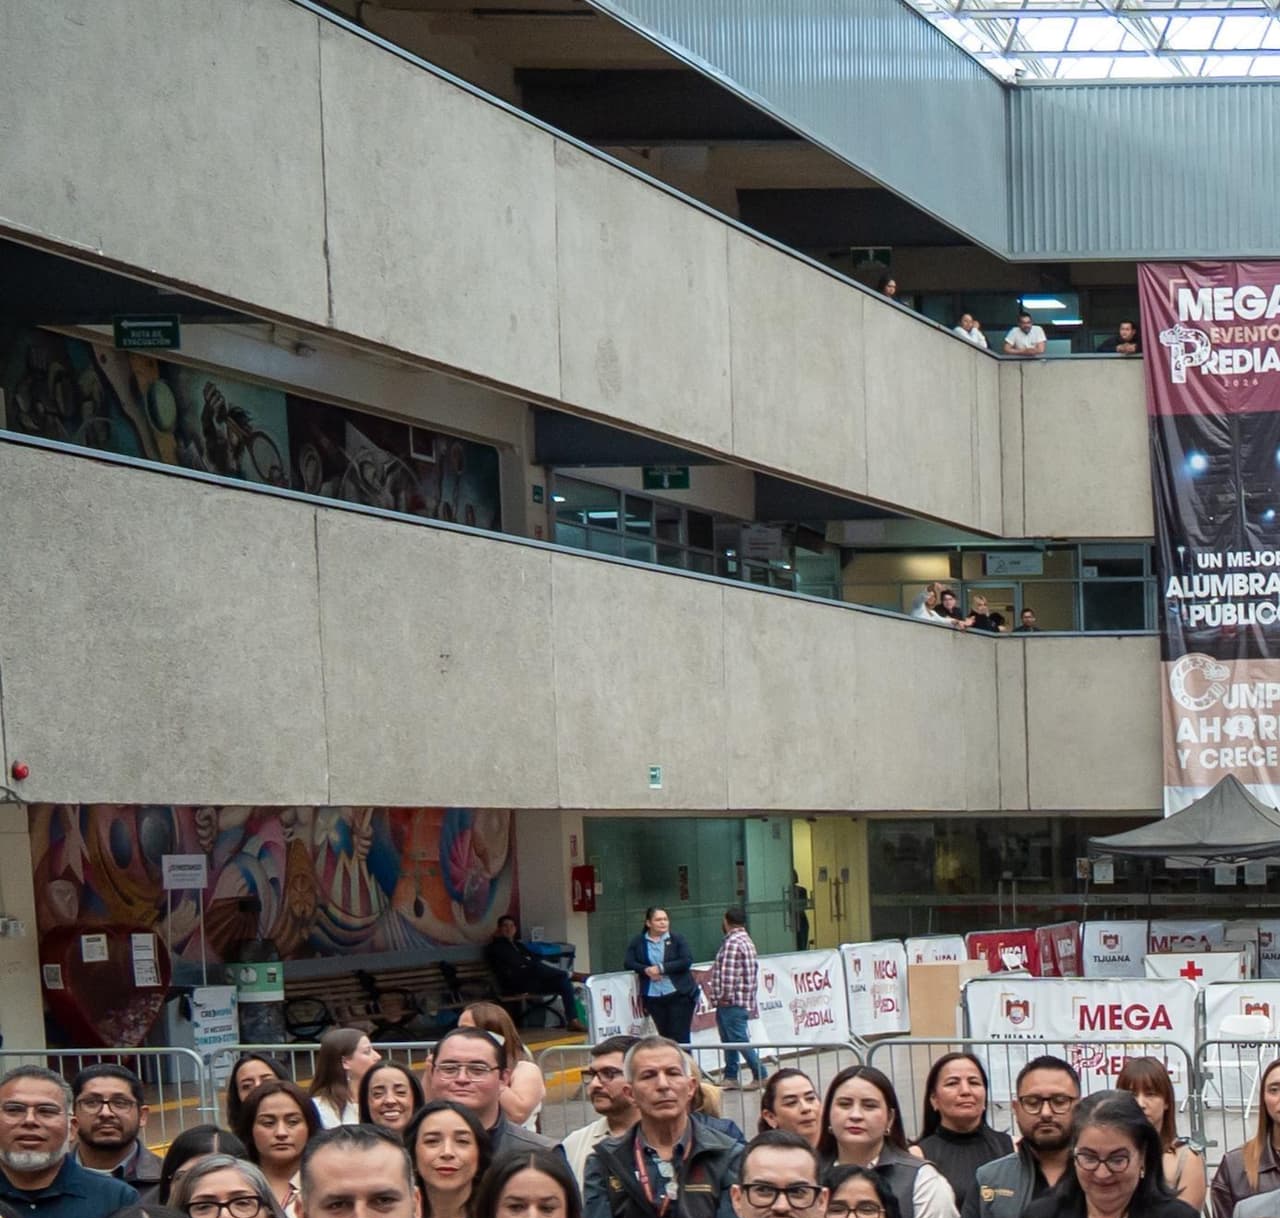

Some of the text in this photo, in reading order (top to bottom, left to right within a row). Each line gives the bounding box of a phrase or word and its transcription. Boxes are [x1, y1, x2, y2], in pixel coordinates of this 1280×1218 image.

[1197, 552, 1222, 568] UN
[1177, 746, 1279, 769] Y CRECE
[1093, 954, 1131, 963] TIJUANA
[794, 970, 832, 995] MEGA
[1079, 1004, 1173, 1030] MEGA
